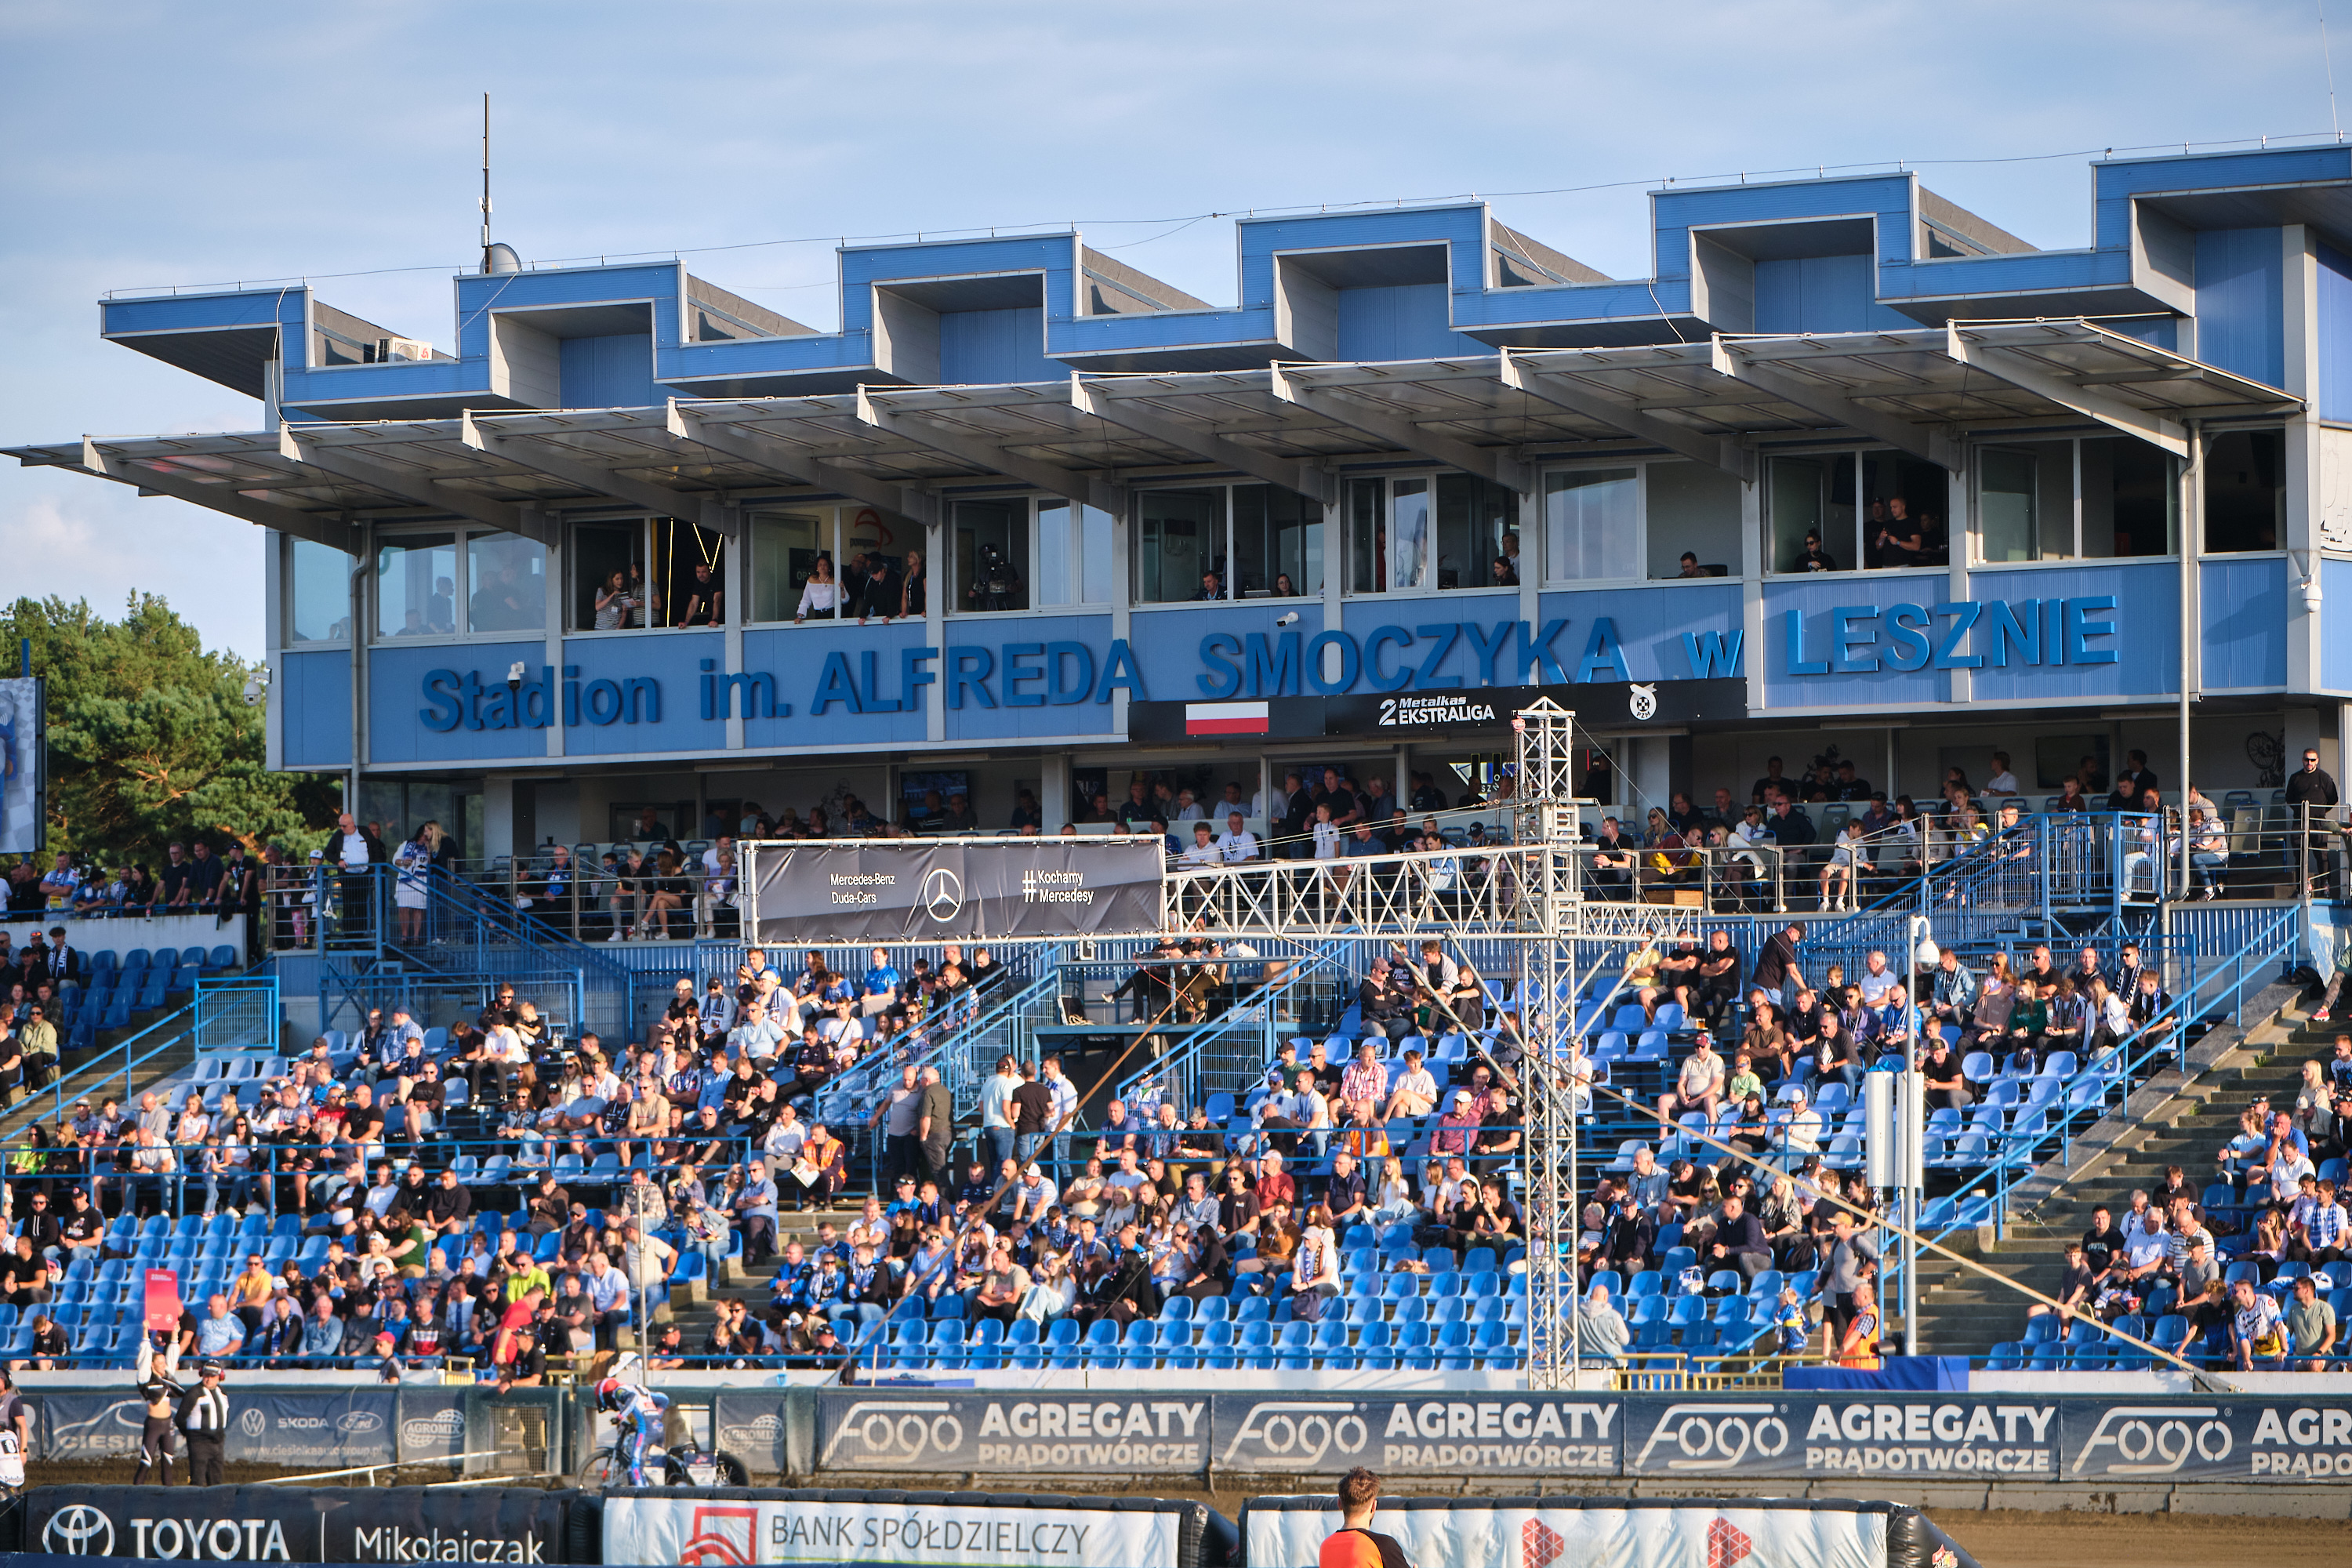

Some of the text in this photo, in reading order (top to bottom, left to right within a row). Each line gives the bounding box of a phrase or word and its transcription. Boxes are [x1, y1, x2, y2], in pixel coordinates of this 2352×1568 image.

[419, 595, 2119, 731] Stadion im. ALFREDA SMOCZYKA w LESZNIE
[1379, 699, 1496, 726] 2 EKSTRALIGA
[1399, 695, 1467, 709] Metalkas
[830, 873, 895, 886] Mercedes-Benz
[831, 891, 877, 904] Duda-Cars
[1039, 887, 1094, 906] Mercedesy
[406, 1421, 461, 1435] AGROMIX
[724, 1428, 779, 1441] AGROMIX
[978, 1402, 1204, 1438] AGREGATY
[1384, 1402, 1619, 1439] AGREGATY
[1806, 1403, 2056, 1443] AGREGATY
[2251, 1408, 2352, 1446] AGR
[978, 1438, 1200, 1471] PRĄDOTWÓRCZE
[1384, 1439, 1614, 1470] PRĄDOTWÓRCZE
[1806, 1443, 2050, 1475] PRĄDOTWÓRCZE
[2251, 1452, 2352, 1479] PRĄDO
[130, 1518, 291, 1561] TOYOTA
[355, 1526, 546, 1565] Mikołajczak
[772, 1511, 1091, 1555] BANK SPÓŁDZIELCZY
